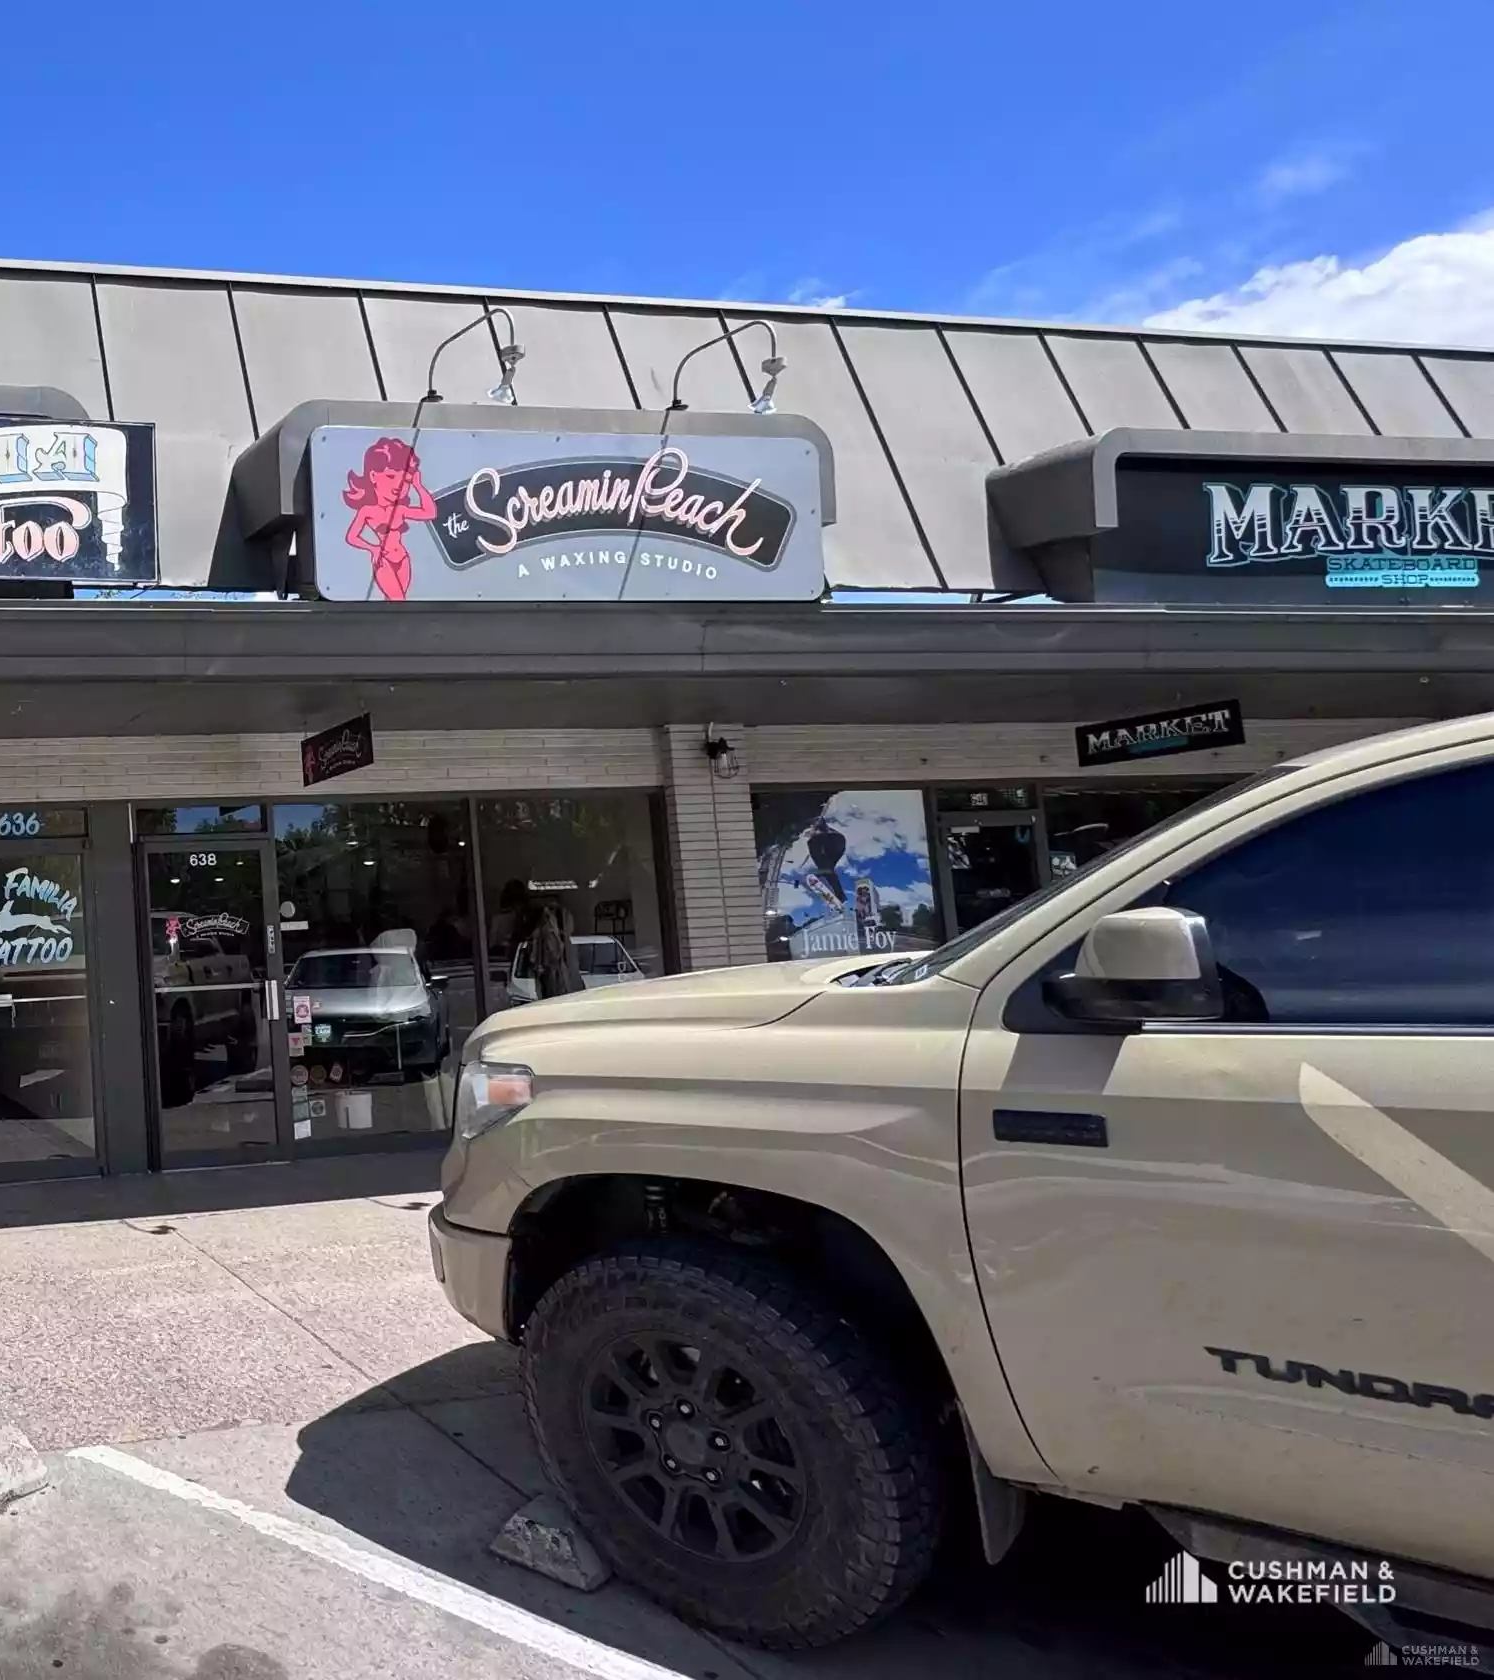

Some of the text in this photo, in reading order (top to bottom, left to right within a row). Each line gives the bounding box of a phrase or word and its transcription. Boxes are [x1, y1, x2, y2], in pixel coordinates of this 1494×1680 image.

[442, 446, 765, 556] the Screamin Peach
[517, 550, 719, 580] A WAXING STUDIO
[1327, 556, 1477, 571] SKATEBOARD
[1380, 573, 1429, 586] SHOP
[1083, 708, 1231, 756] MARKET
[189, 852, 217, 867] 638
[4, 866, 78, 922] FAMILIA
[800, 925, 898, 958] Jamie Foy
